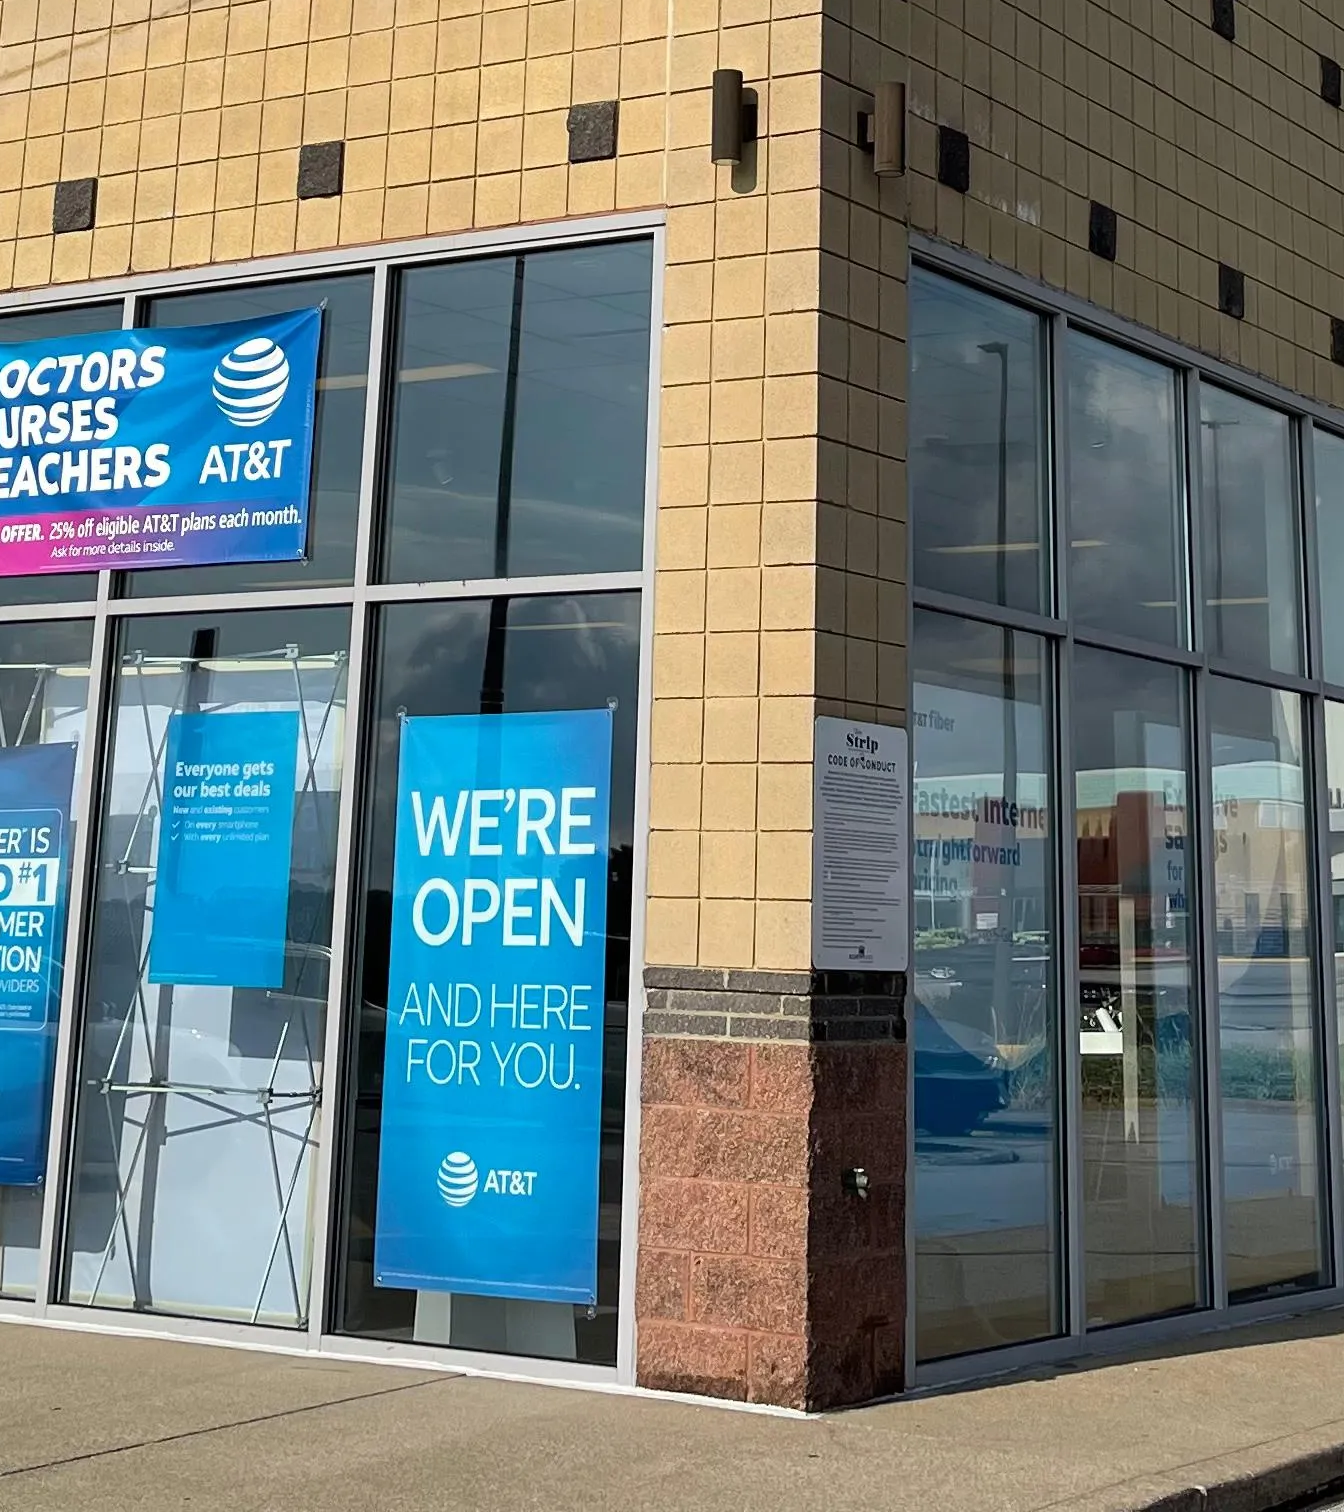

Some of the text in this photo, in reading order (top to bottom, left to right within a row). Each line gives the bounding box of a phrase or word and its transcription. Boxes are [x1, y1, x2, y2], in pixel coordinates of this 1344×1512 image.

[198, 438, 292, 485] AT&T
[1, 524, 44, 543] OFFER.
[50, 522, 75, 540] 25%
[76, 519, 94, 538] off
[95, 515, 140, 540] eligible
[142, 514, 180, 534] AT&T
[180, 511, 216, 537] plans
[217, 511, 249, 529] each
[251, 507, 303, 526] month.
[50, 539, 175, 559] Ask for more details inside.
[929, 710, 955, 732] fiber
[846, 733, 878, 754] Strip
[175, 760, 274, 781] Everyone gets
[828, 754, 848, 768] CODE
[850, 757, 859, 768] OF
[173, 780, 271, 798] our best deals
[173, 806, 189, 815] New
[204, 805, 233, 816] existing
[411, 786, 597, 857] WE'RE
[196, 821, 216, 831] every
[200, 833, 221, 843] every
[30, 827, 51, 854] IS
[913, 834, 1021, 866] traightforward
[18, 861, 48, 902] #1
[412, 877, 586, 947] OPEN
[399, 982, 592, 1032] AND HERE
[404, 1038, 581, 1091] FOR YOU.
[483, 1170, 537, 1196] AT&T
